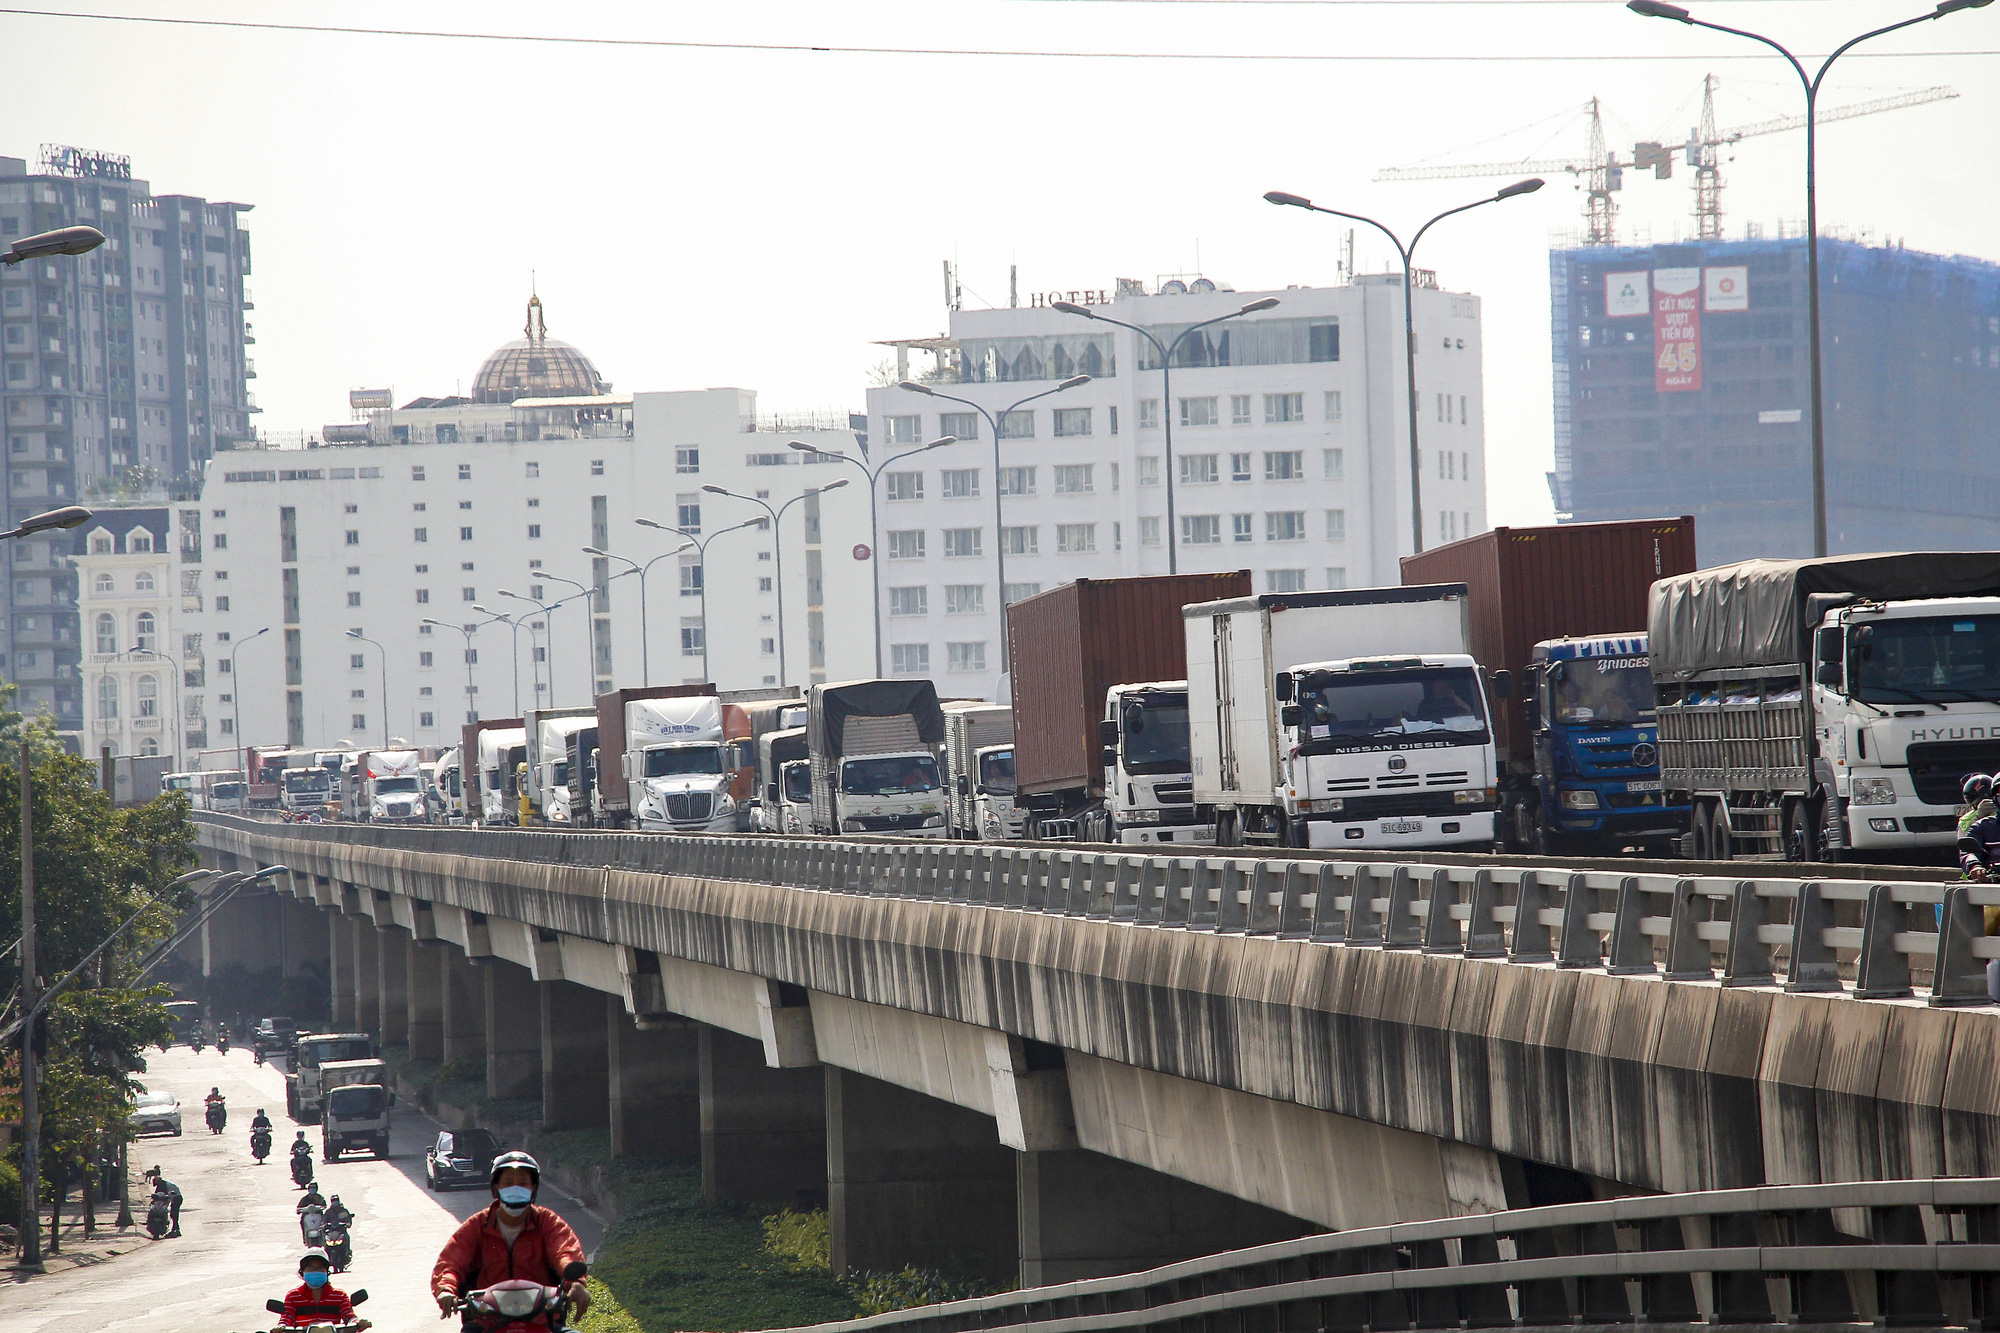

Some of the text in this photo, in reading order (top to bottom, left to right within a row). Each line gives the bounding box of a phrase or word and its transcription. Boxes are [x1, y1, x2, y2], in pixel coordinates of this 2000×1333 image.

[1031, 290, 1110, 308] HOTEL
[1658, 342, 1697, 373] 45
[1666, 374, 1692, 385] NGÀY
[1335, 741, 1456, 753] NISSAN DIESEL
